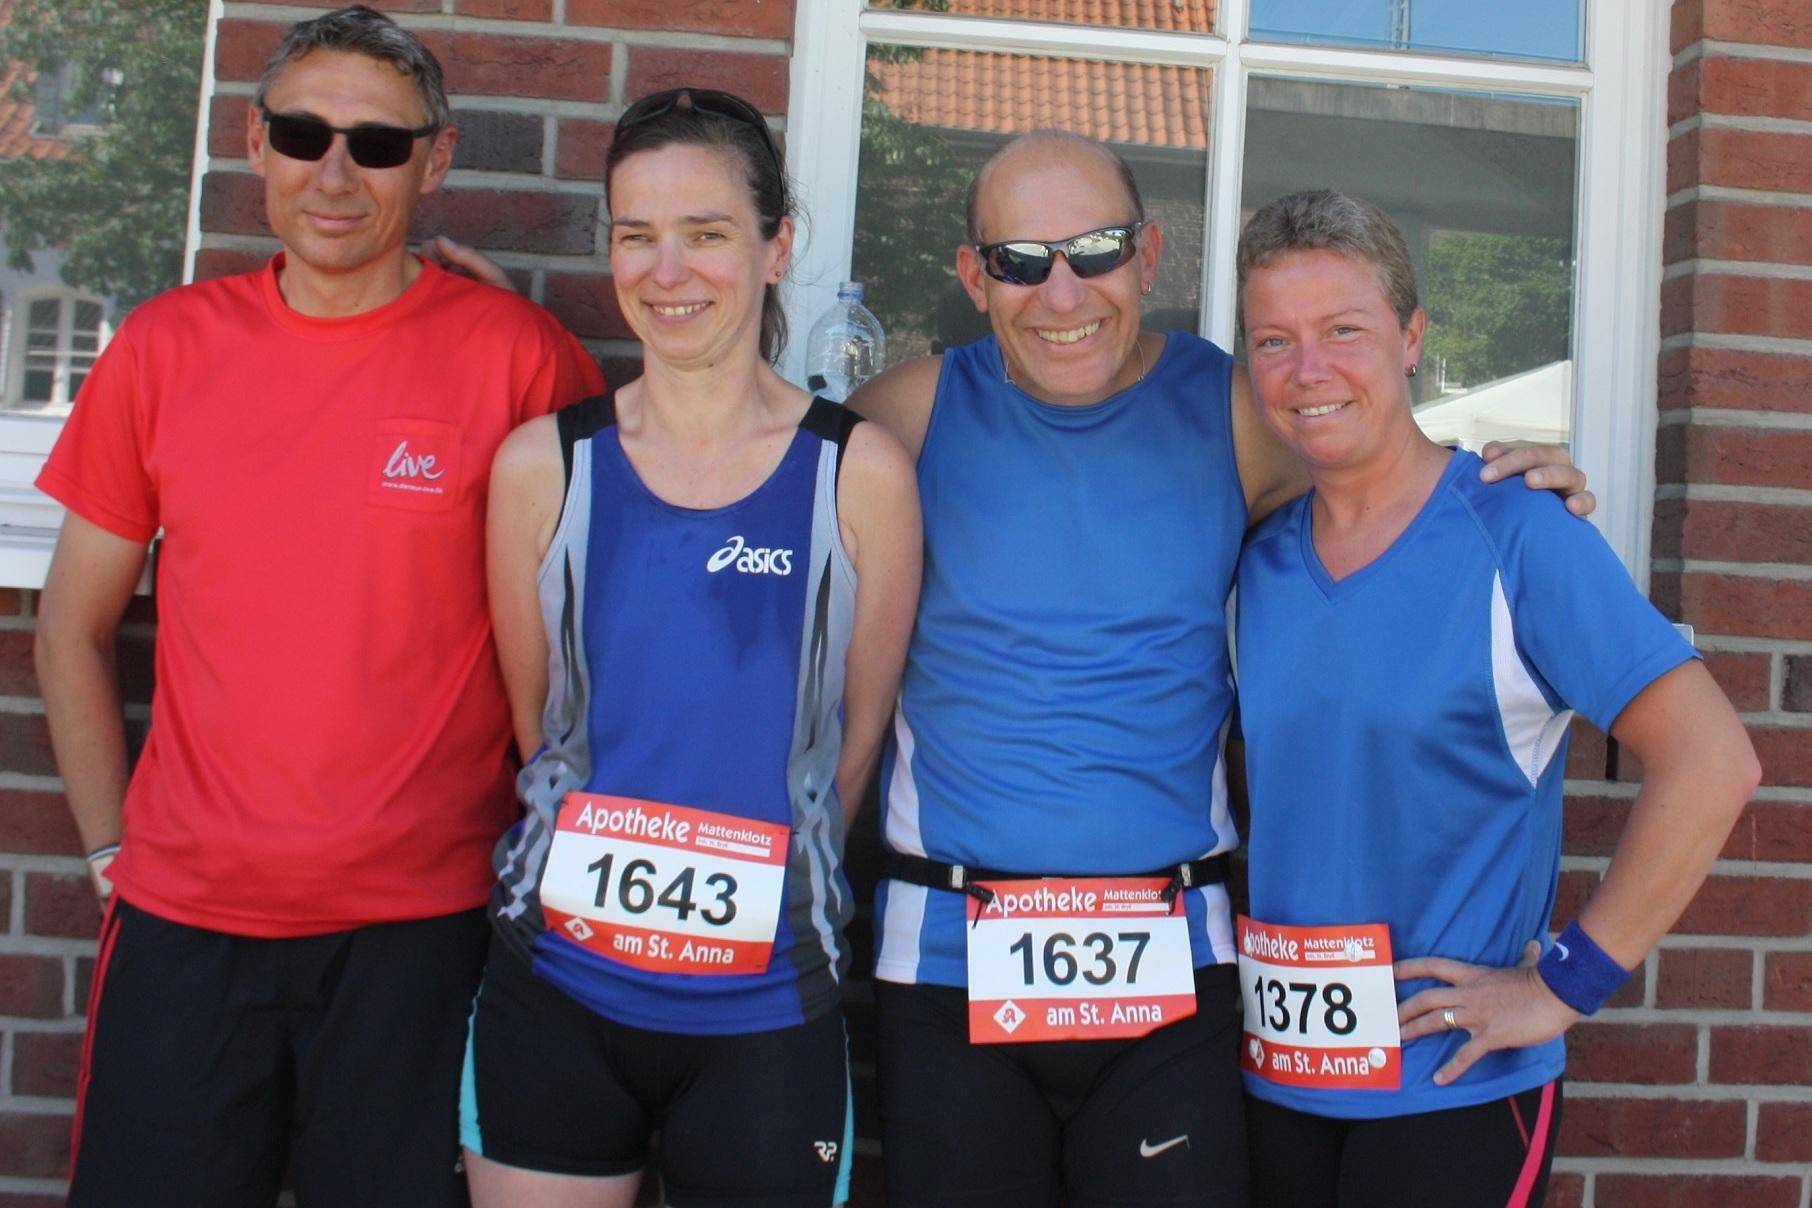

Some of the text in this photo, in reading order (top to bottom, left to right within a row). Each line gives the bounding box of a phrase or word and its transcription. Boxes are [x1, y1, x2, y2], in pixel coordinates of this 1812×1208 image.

[576, 801, 691, 844] Apotheke
[697, 822, 772, 846] Mattenklotz
[587, 853, 738, 926] 1643
[986, 887, 1097, 917] Apotheke
[613, 933, 735, 964] am St. Anna
[1010, 932, 1151, 986] 1637
[1047, 1002, 1162, 1025] am St. Anna
[1254, 976, 1357, 1035] 1378
[1272, 1051, 1369, 1075] am St. Anna
